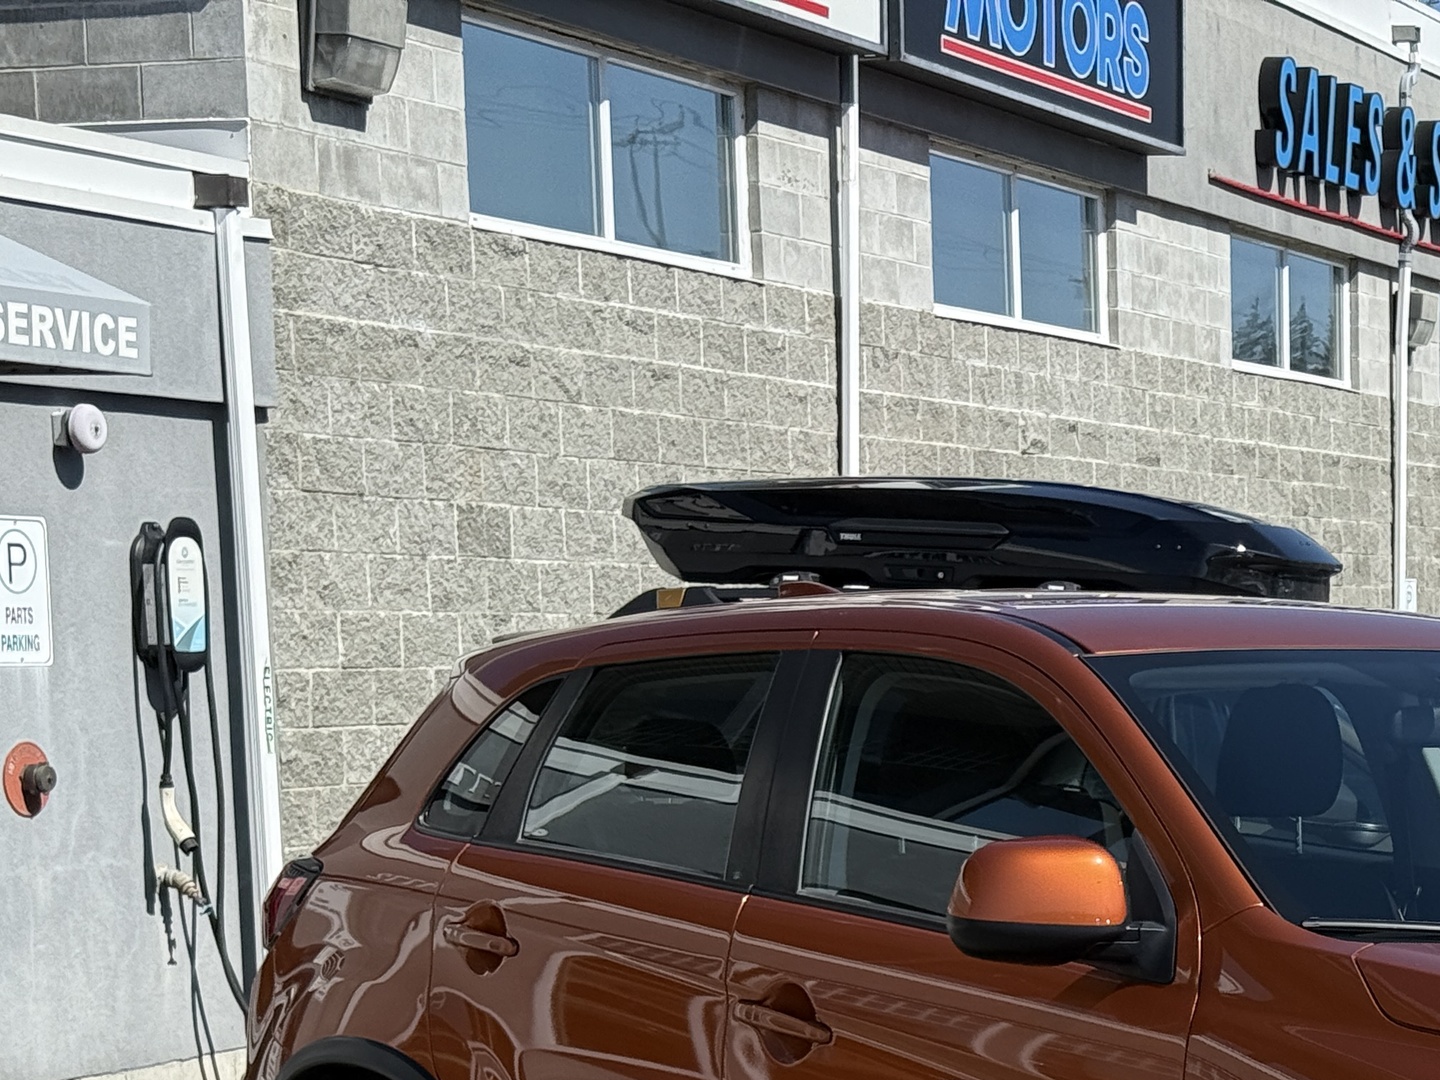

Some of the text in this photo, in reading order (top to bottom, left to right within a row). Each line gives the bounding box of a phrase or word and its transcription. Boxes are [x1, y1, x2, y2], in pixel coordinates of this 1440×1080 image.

[1274, 57, 1385, 196] SALES
[1396, 106, 1417, 210] &
[0, 301, 139, 360] ERVICE
[7, 542, 28, 585] P
[5, 606, 34, 625] PARTS
[1, 633, 41, 652] PARKING
